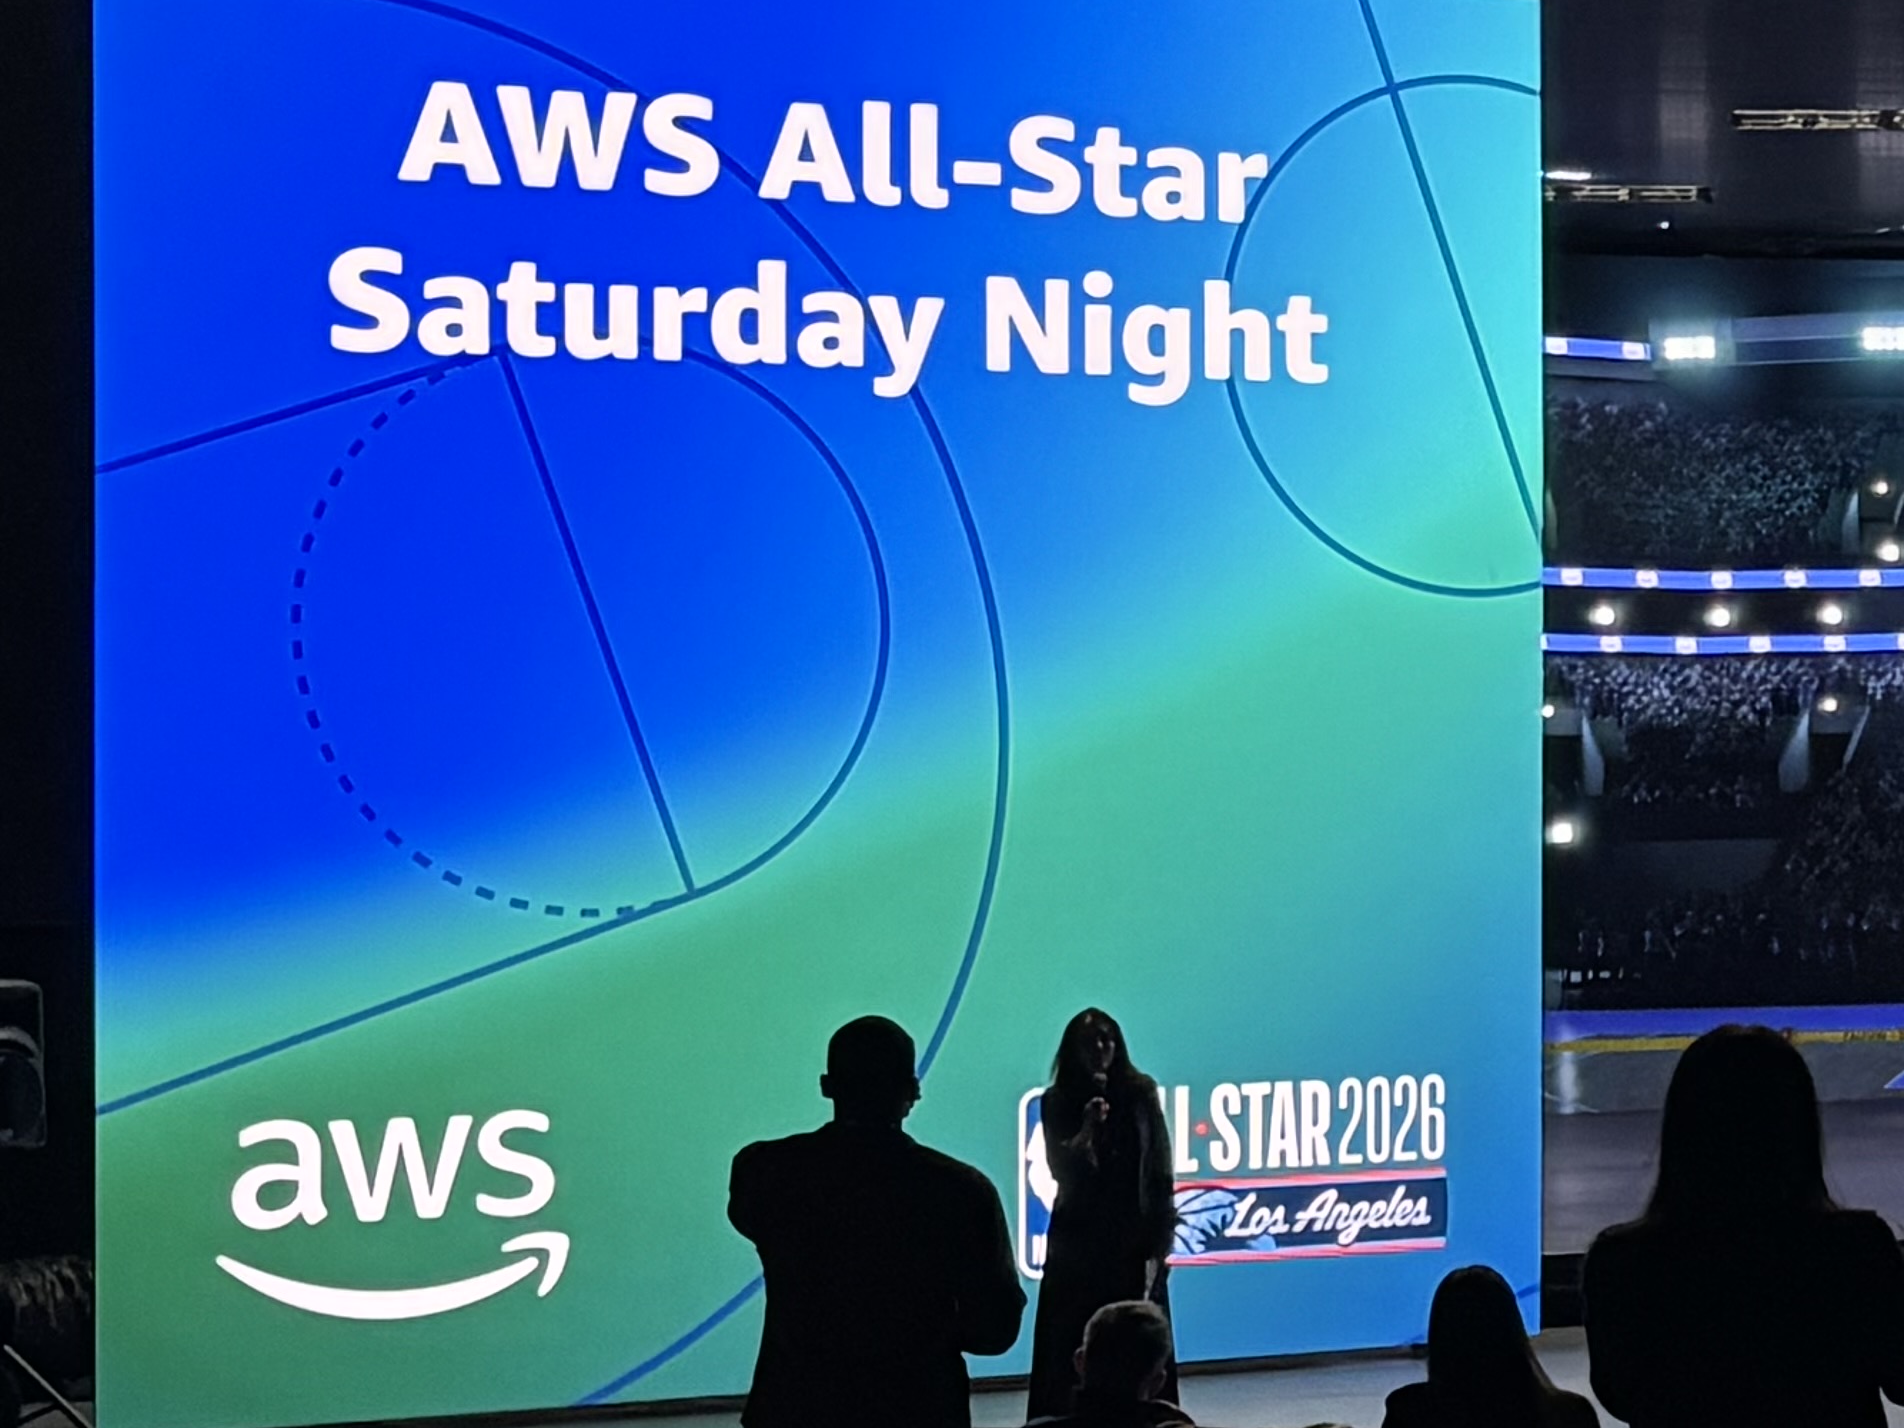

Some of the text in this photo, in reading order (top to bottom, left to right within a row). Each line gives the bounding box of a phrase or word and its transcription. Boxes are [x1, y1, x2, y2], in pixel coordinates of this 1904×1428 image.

[398, 81, 1268, 223] AWS All-Star
[329, 247, 1329, 406] Saturday Night
[231, 1109, 555, 1230] aws
[1338, 1074, 1446, 1165] 2026
[1227, 1184, 1432, 1246] Los Angeles
